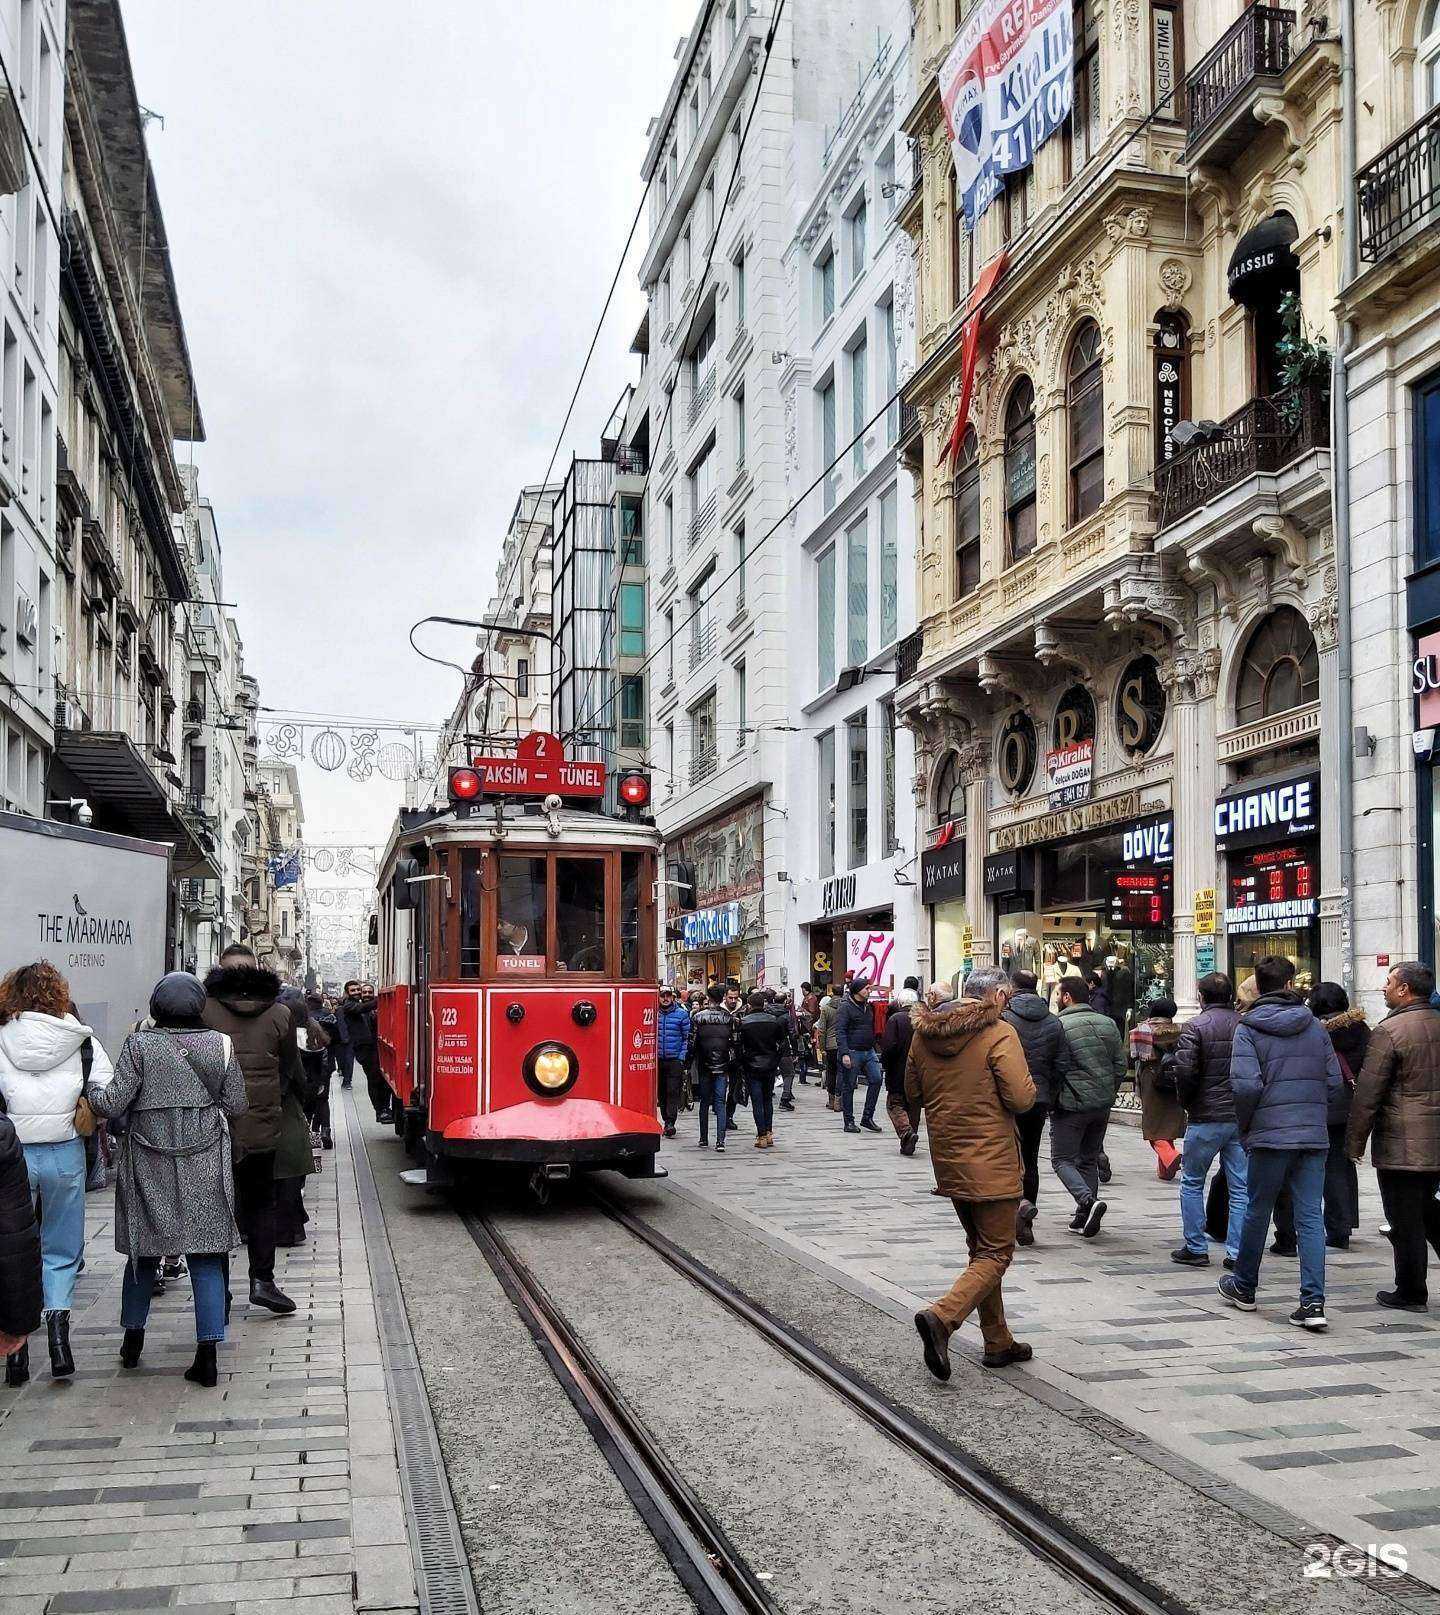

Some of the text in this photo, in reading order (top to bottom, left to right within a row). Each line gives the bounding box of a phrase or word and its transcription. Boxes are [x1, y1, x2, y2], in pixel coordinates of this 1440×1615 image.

[1164, 390, 1173, 415] NEO
[536, 736, 546, 757] 2
[1058, 743, 1092, 767] Kiralık
[559, 764, 601, 787] TÜNEL
[1215, 781, 1310, 836] CHANGE
[1123, 820, 1169, 861] DÖVİZ
[1196, 912, 1213, 922] UNION
[38, 914, 132, 944] THE MARMARA
[69, 953, 105, 968] CATERING
[503, 957, 541, 968] TÜNEL
[442, 1008, 457, 1026] 223
